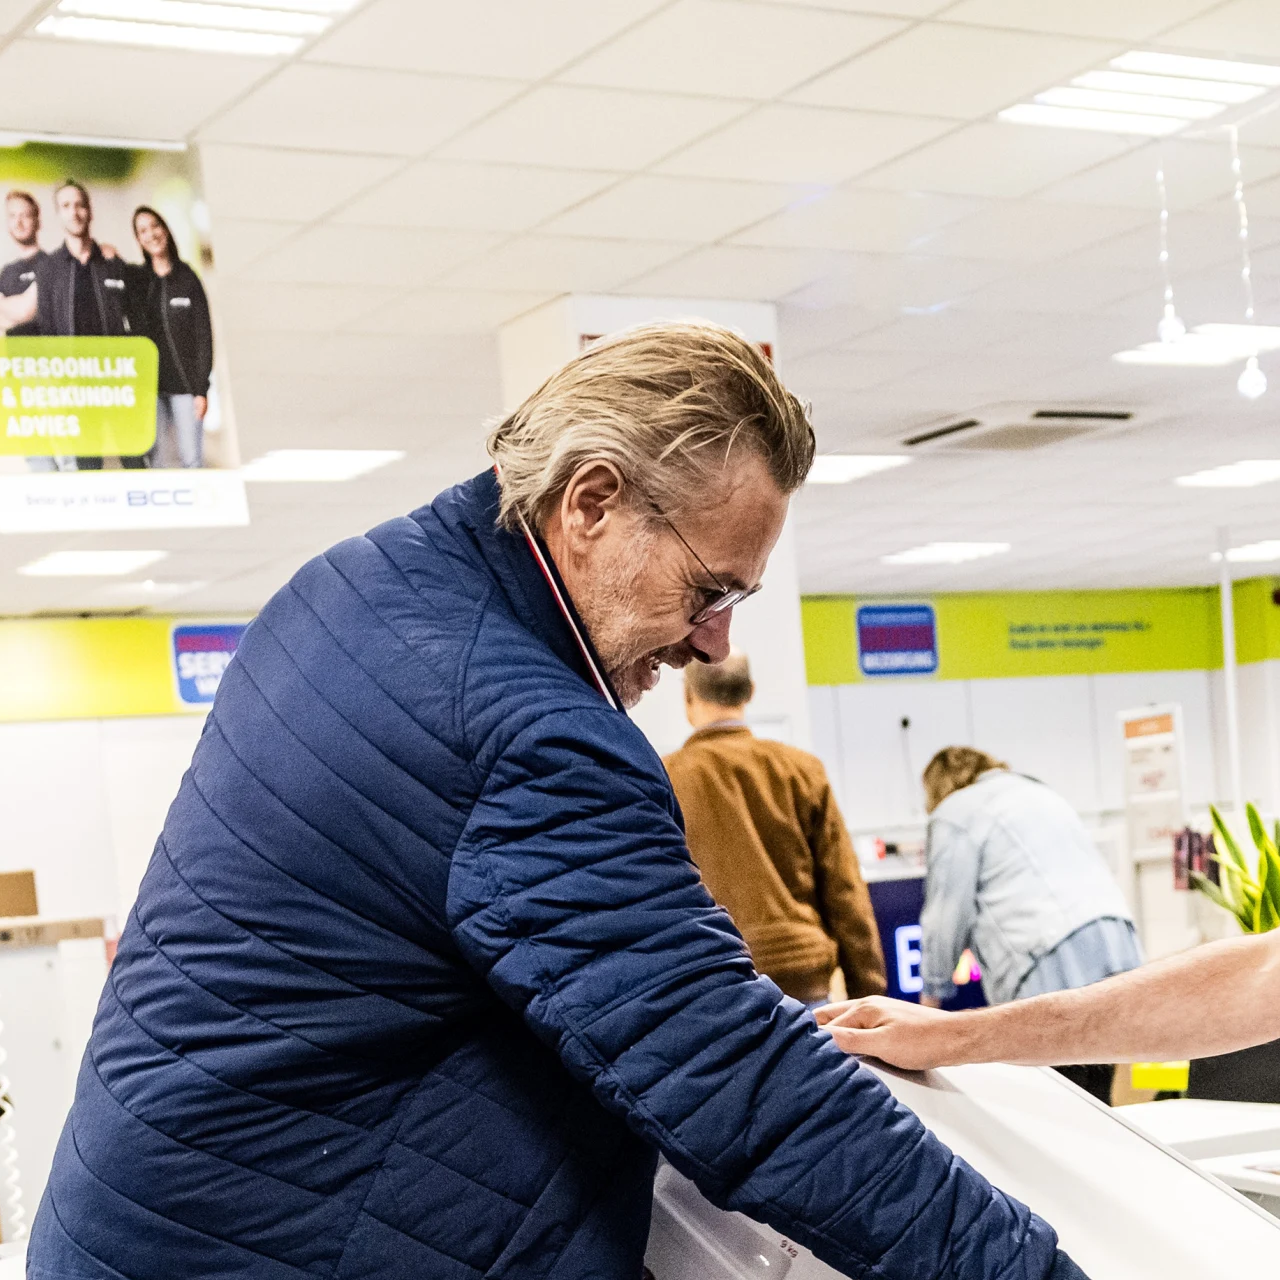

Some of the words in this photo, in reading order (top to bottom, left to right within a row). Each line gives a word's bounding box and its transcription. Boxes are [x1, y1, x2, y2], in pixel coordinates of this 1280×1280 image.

[2, 386, 17, 408] &
[21, 385, 136, 408] DESKUNDIG
[6, 415, 81, 437] ADVIES
[127, 490, 193, 507] BCC
